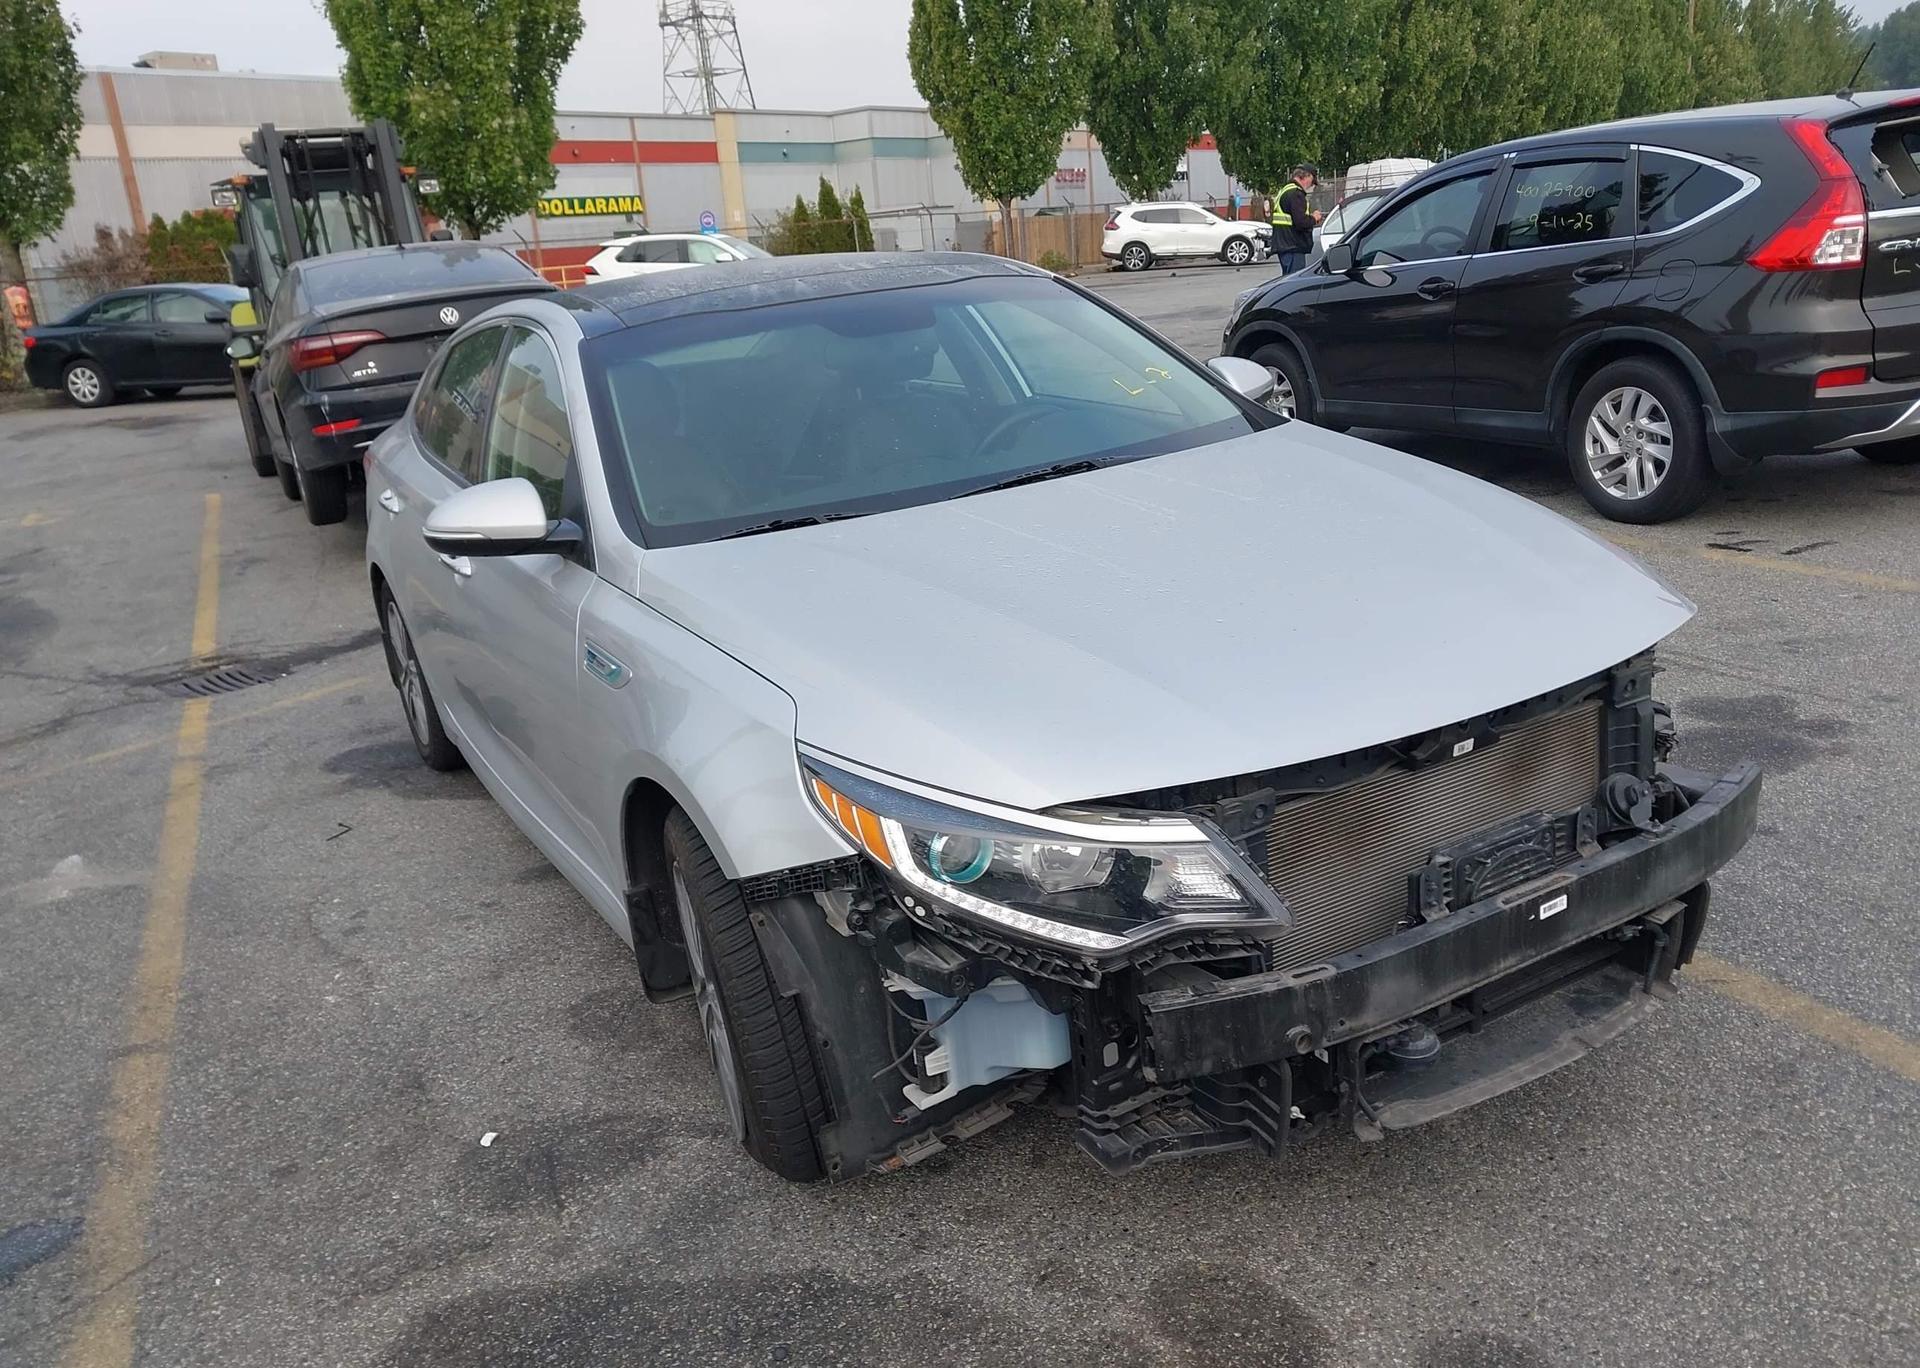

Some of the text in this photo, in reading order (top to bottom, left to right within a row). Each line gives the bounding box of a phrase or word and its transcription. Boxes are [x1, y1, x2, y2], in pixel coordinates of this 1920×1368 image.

[537, 196, 644, 216] DOLLARAMA
[1529, 212, 1594, 232] 9-11-25
[352, 368, 378, 378] JETTA
